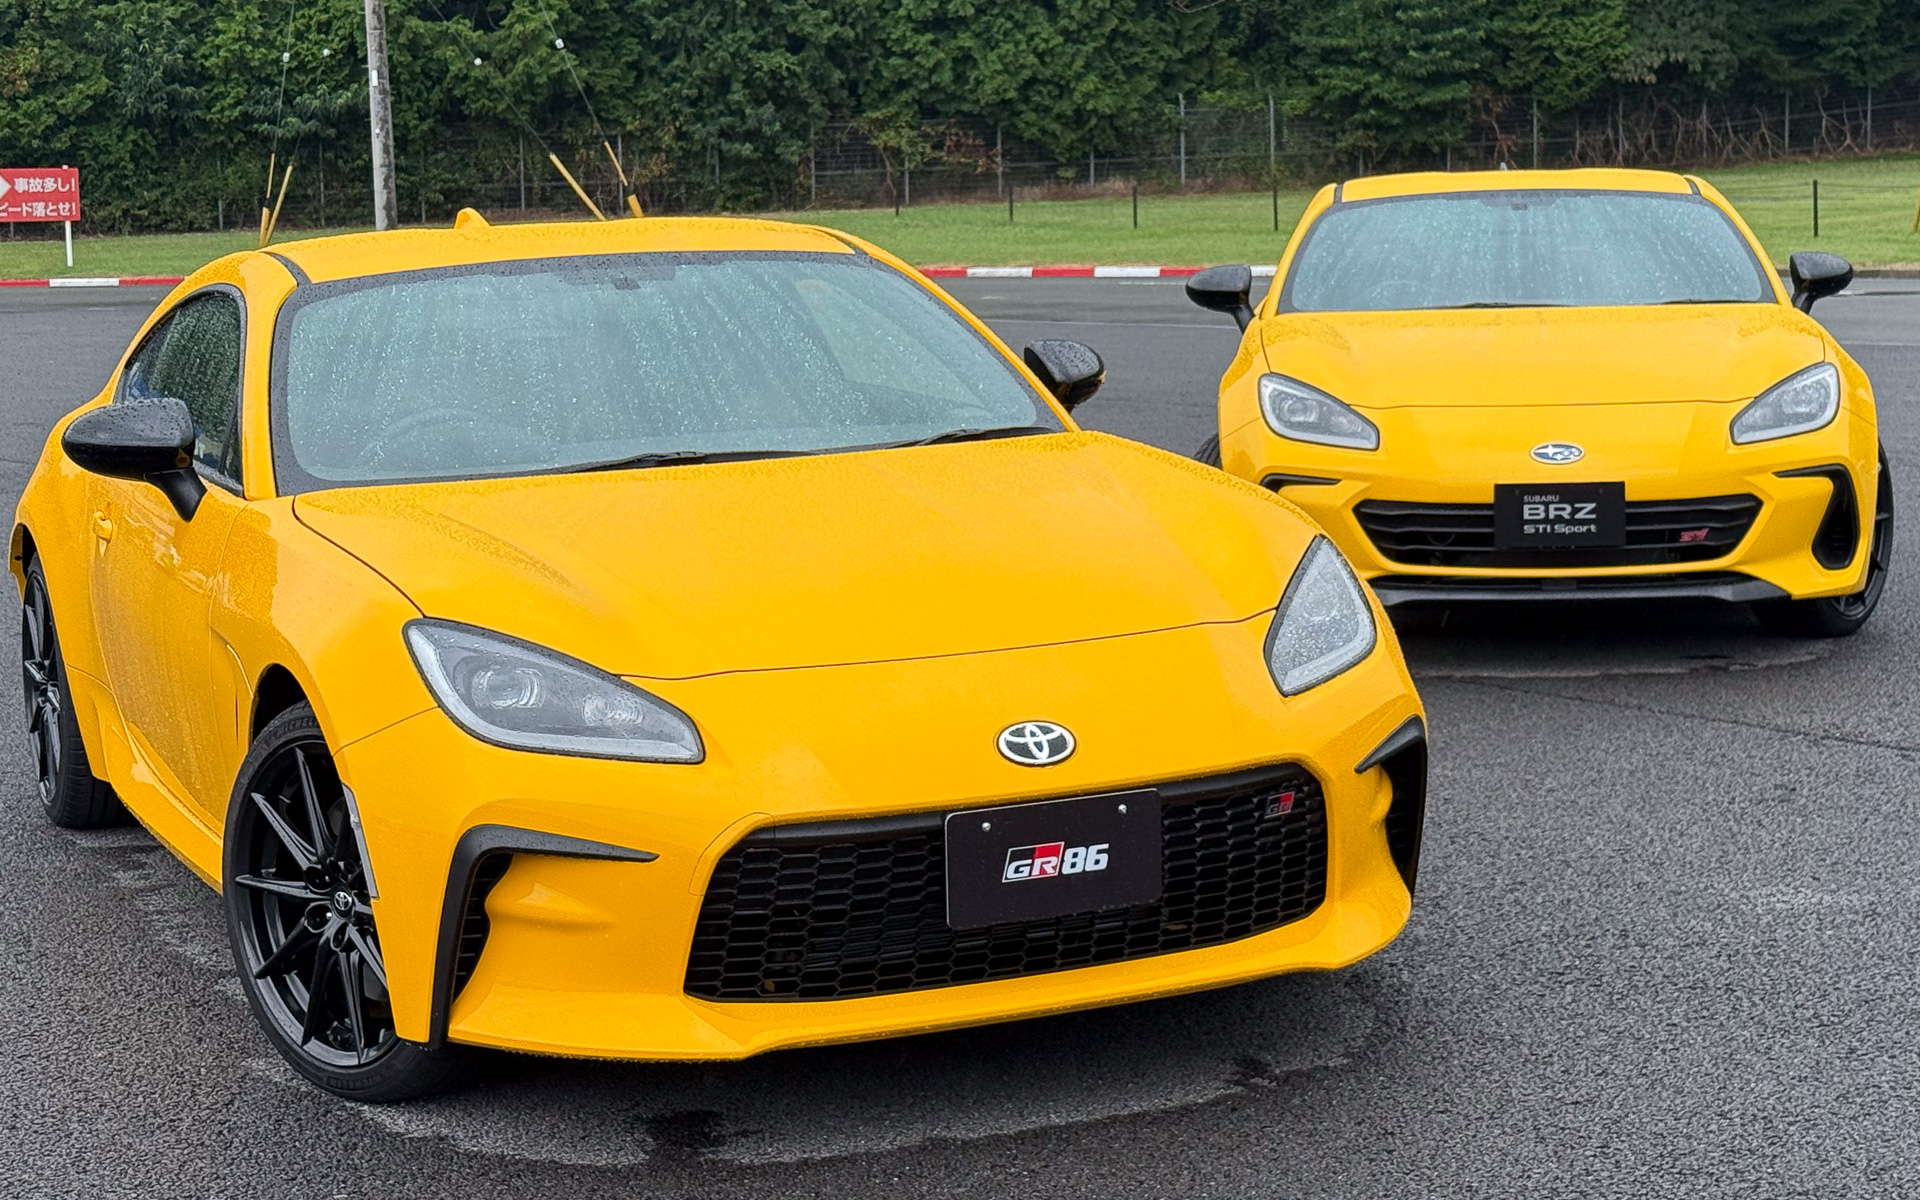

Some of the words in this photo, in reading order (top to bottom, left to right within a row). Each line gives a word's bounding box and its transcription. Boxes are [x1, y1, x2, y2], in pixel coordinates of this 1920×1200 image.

[14, 177, 76, 193] 事故多し!
[1523, 494, 1560, 503] SUBARU
[1523, 502, 1597, 520] BRZ
[1523, 524, 1551, 534] STI
[1554, 523, 1597, 535] Sport
[1267, 799, 1292, 816] GR
